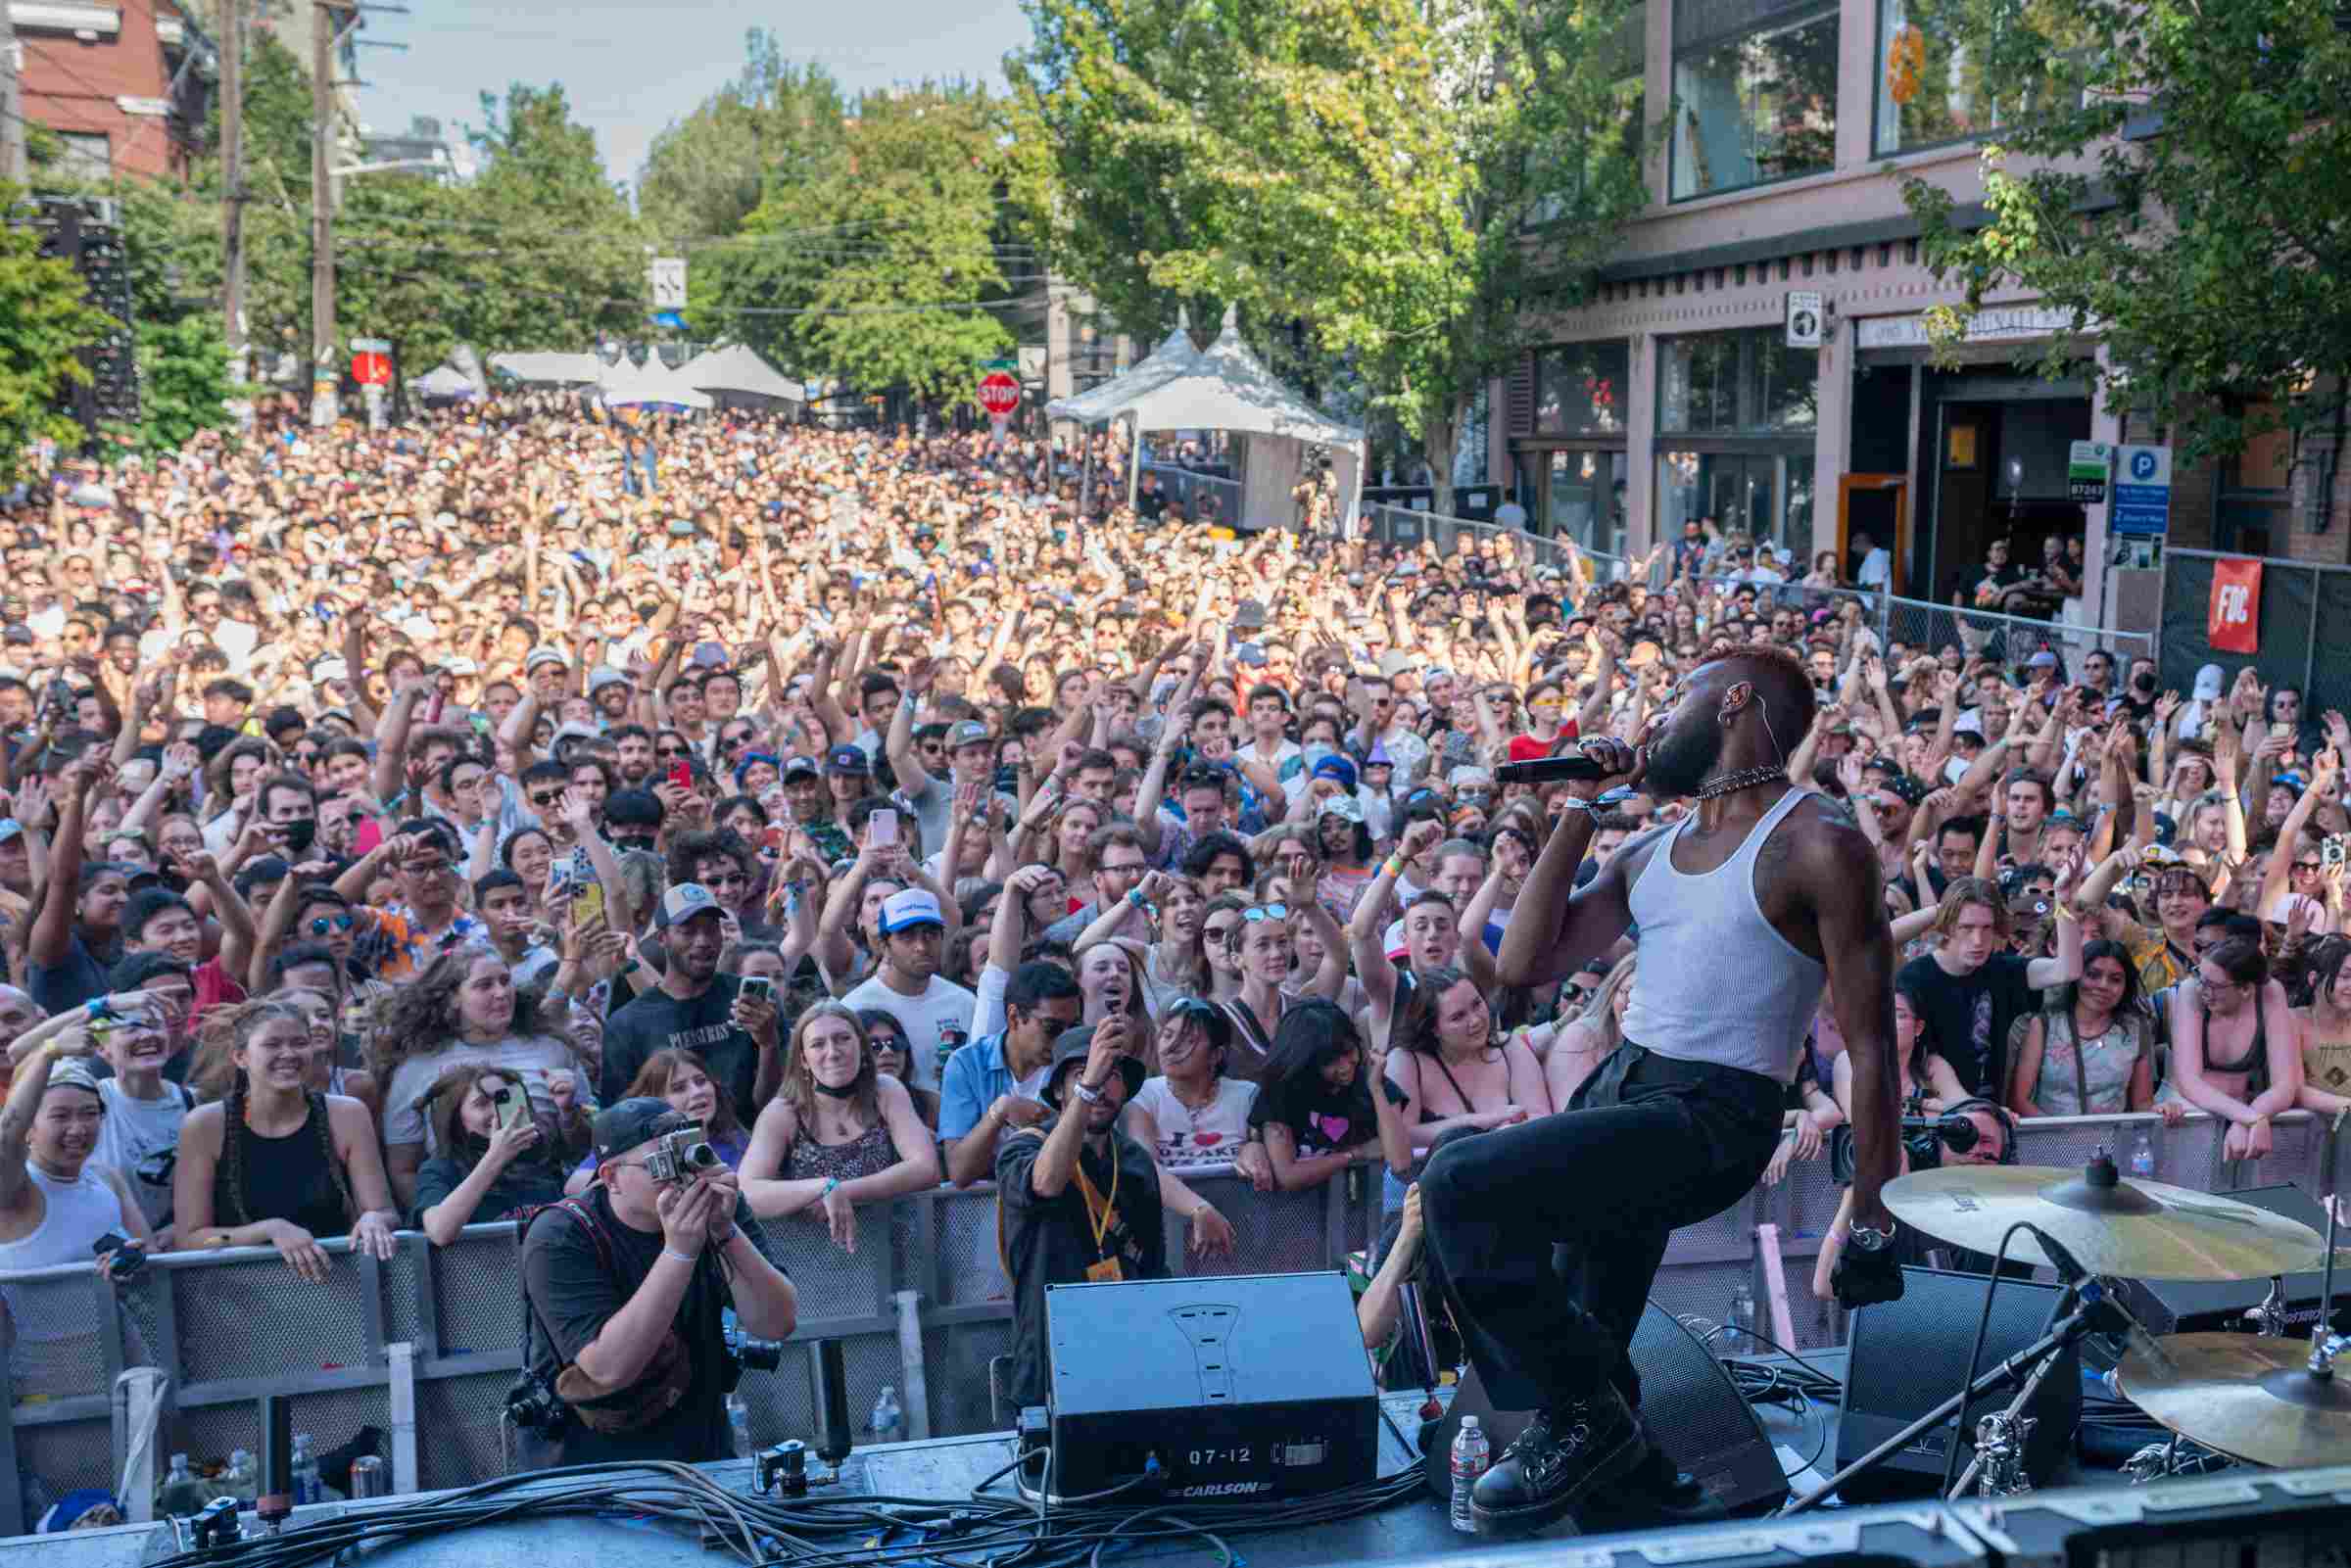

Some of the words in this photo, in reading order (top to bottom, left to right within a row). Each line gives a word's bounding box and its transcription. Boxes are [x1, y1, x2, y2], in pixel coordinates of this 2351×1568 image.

[982, 385, 1016, 402] STOP
[1170, 1132, 1185, 1147] I
[1189, 1447, 1251, 1465] 07-12
[1182, 1481, 1259, 1497] CARLSON
